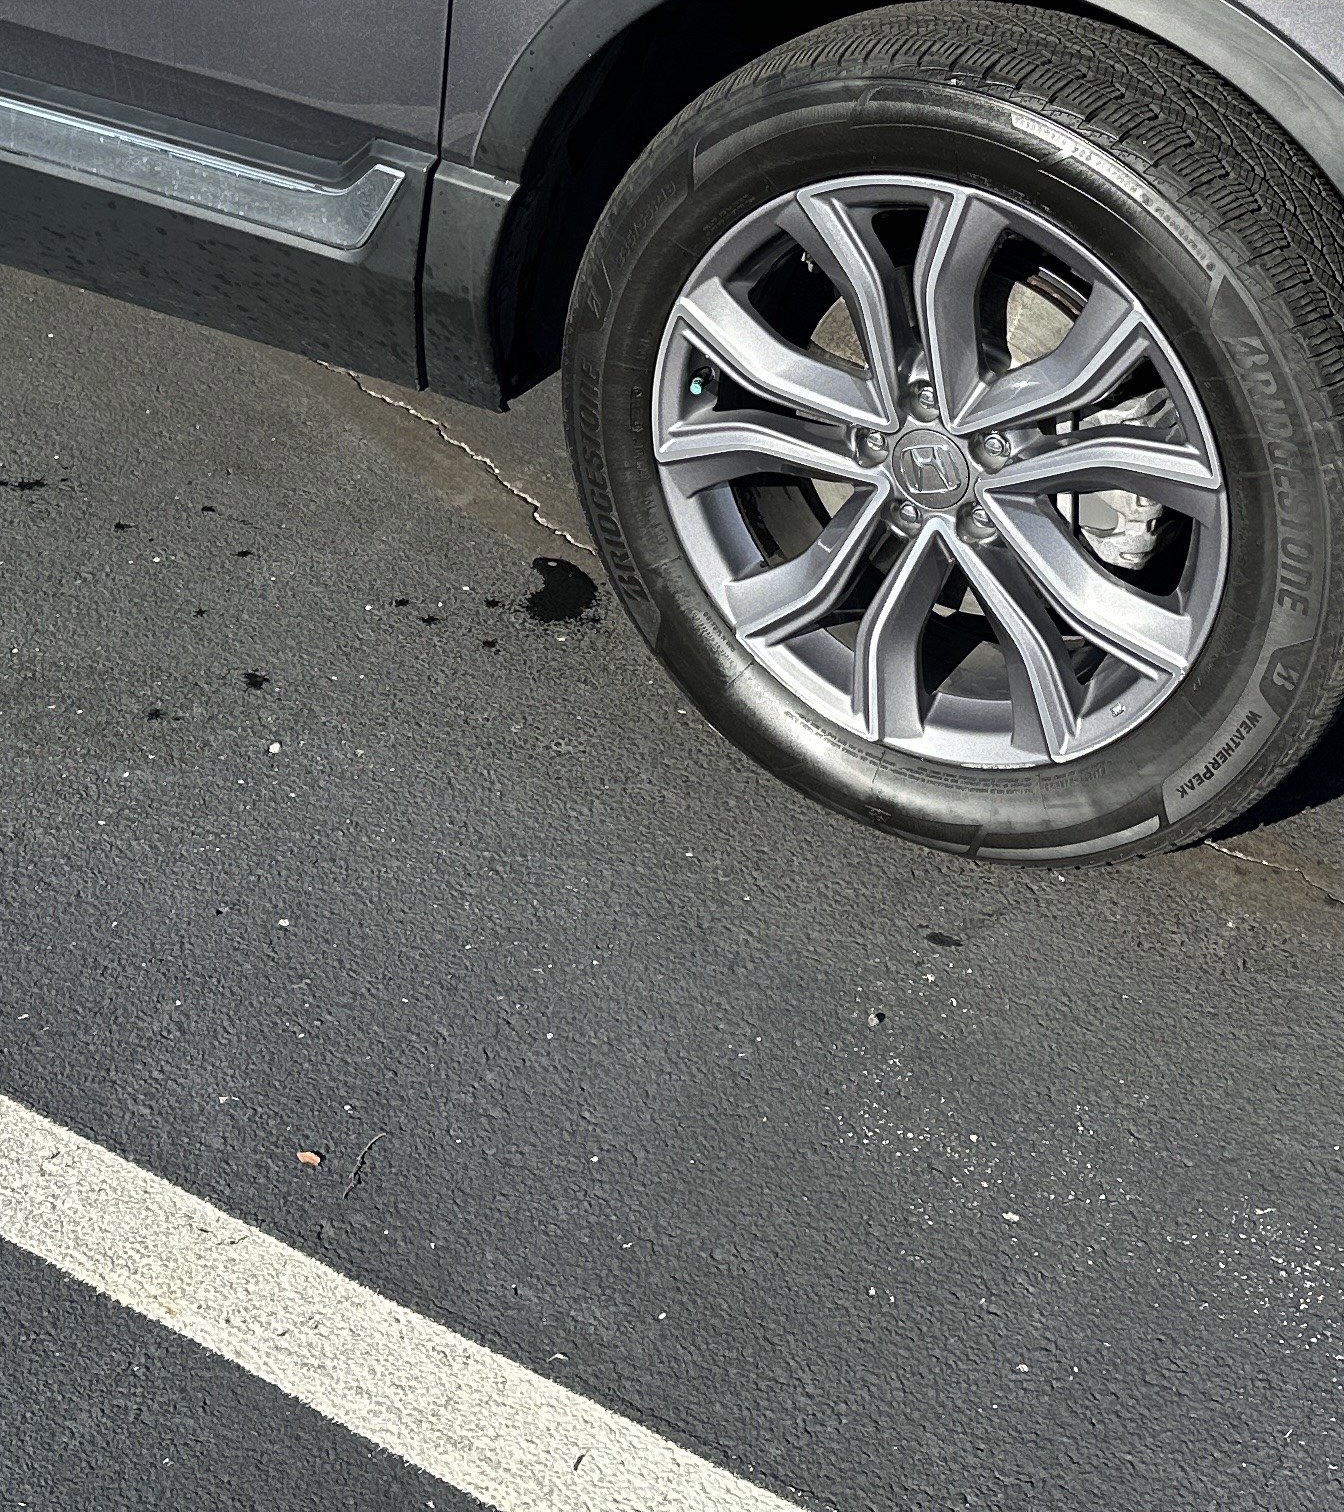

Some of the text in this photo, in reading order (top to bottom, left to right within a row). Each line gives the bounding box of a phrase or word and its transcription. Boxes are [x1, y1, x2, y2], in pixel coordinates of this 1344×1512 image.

[578, 359, 651, 604] BRIDGESTONE
[1221, 335, 1316, 618] BRIDGESTONE
[1175, 710, 1263, 799] WEATHERPEAK
